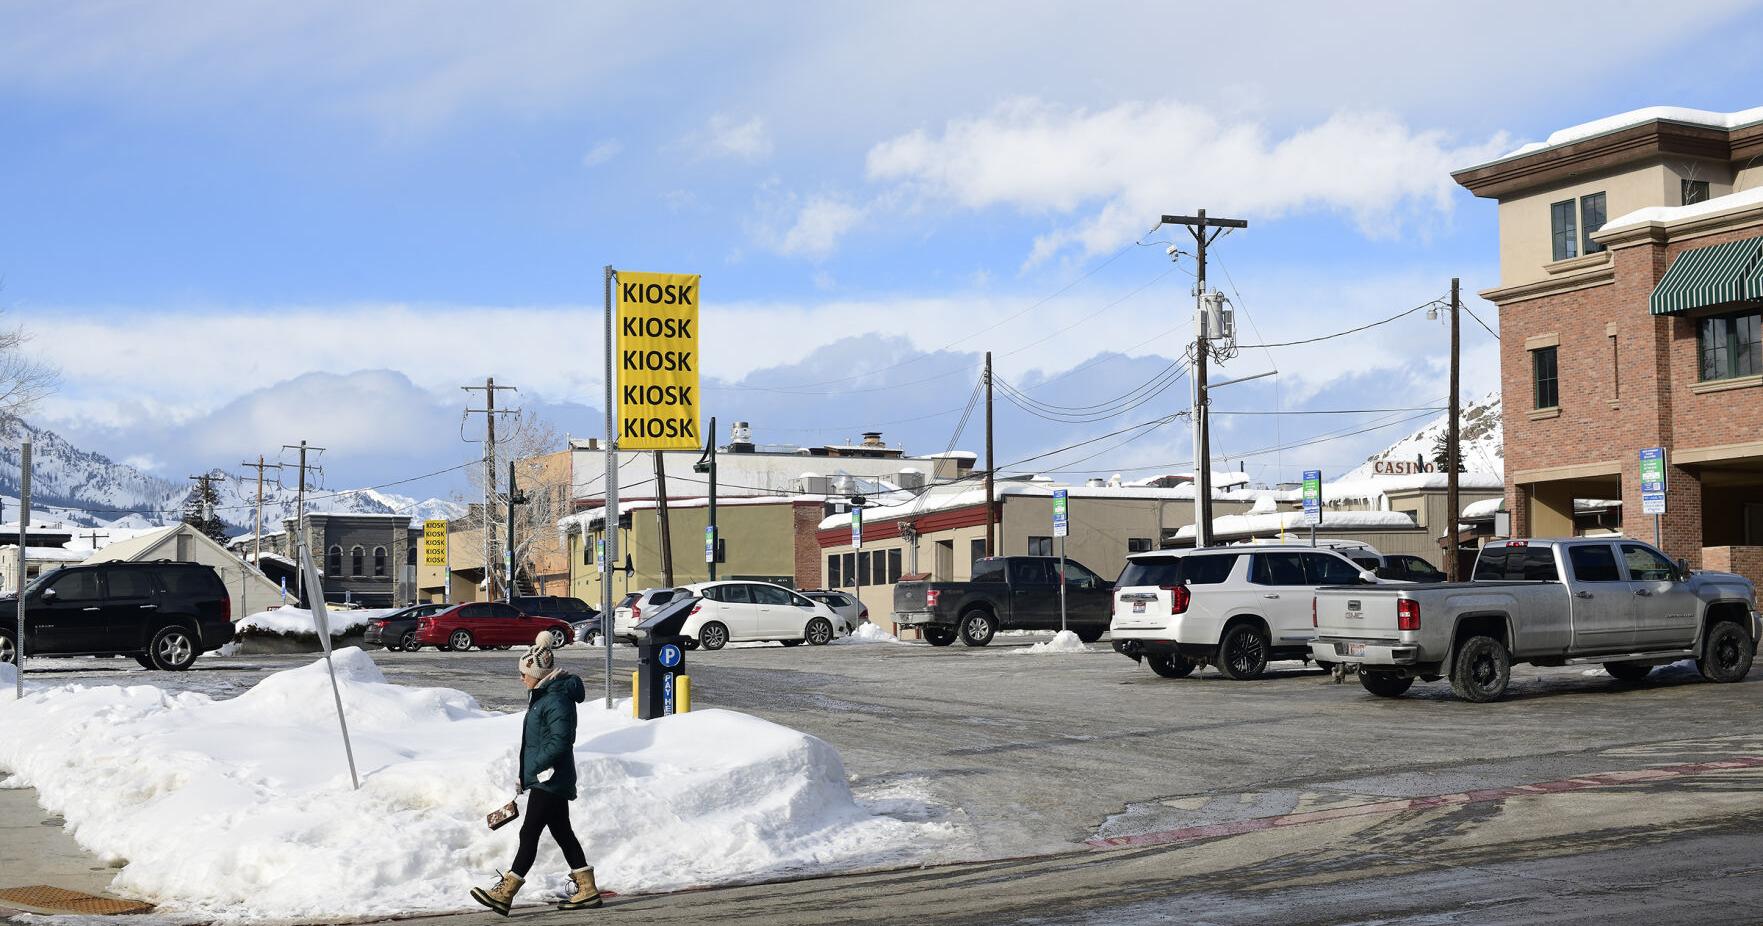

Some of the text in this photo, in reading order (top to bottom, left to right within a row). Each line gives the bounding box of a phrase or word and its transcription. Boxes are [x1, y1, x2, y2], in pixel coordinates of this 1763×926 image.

[623, 283, 692, 305] KIOSK
[623, 317, 691, 338] KIOSK
[623, 350, 691, 371] KIOSK
[623, 385, 692, 405] KIOSK
[624, 417, 694, 438] KIOSK
[1375, 462, 1434, 475] CASINO
